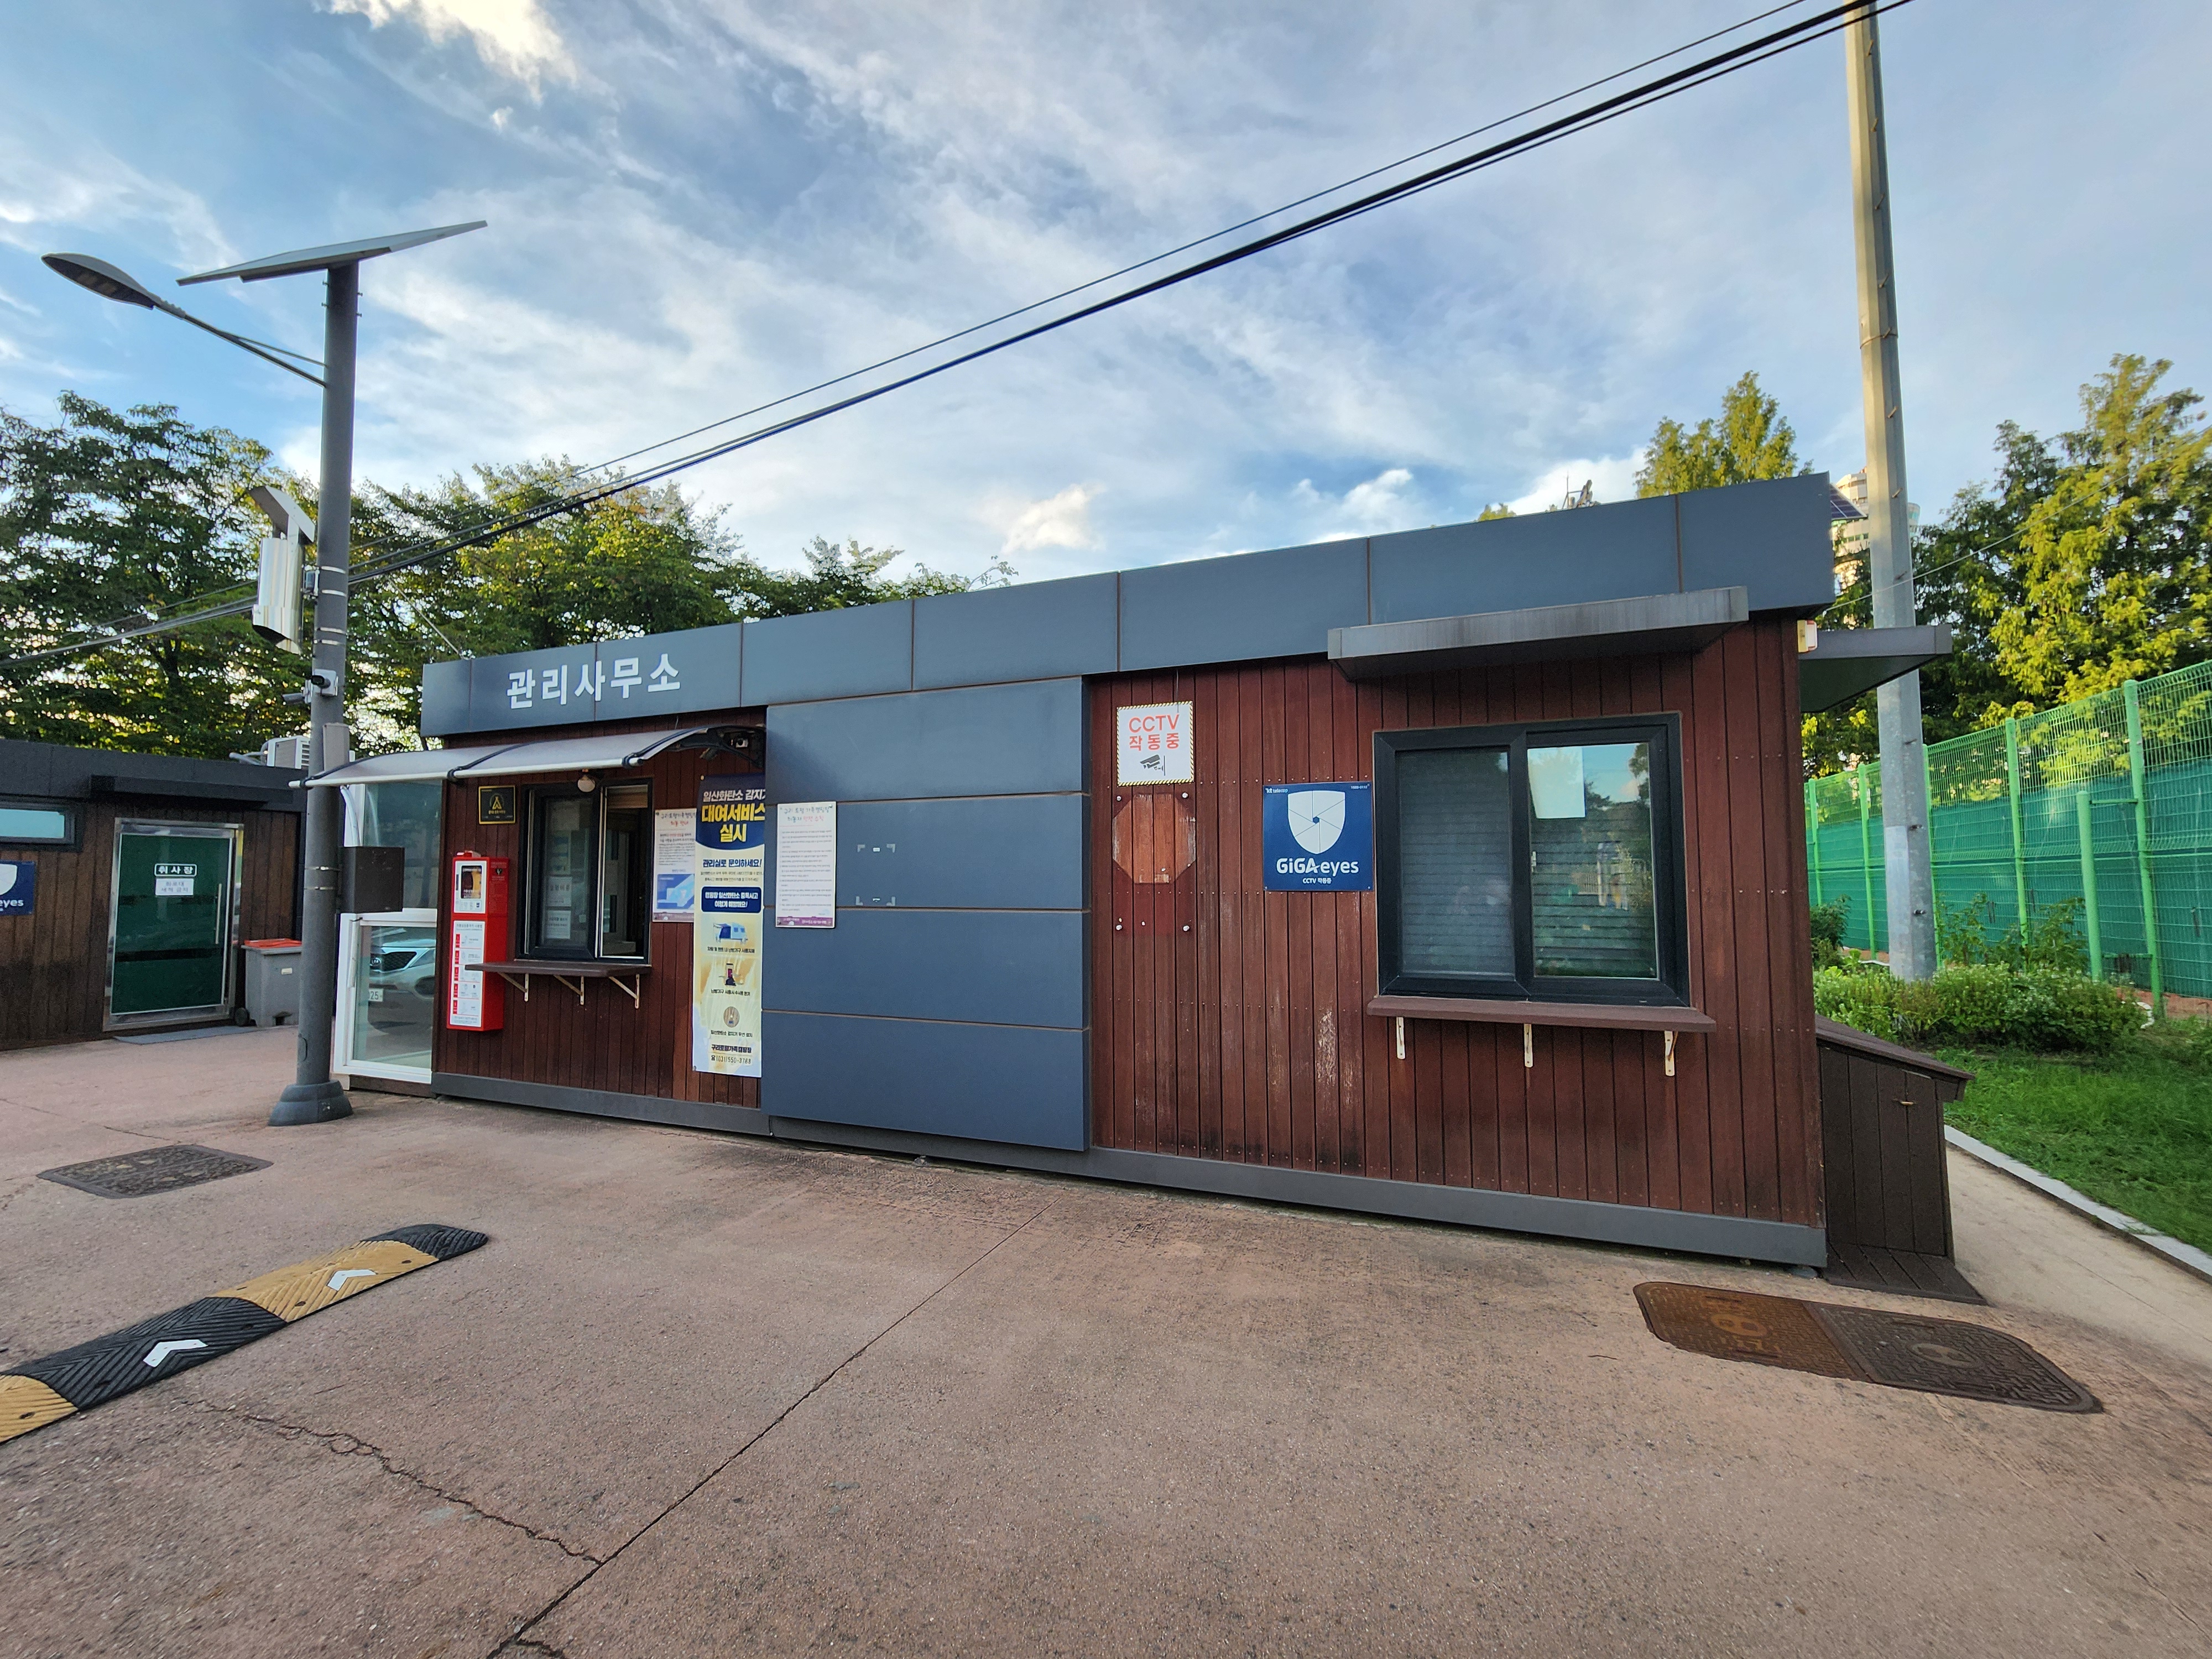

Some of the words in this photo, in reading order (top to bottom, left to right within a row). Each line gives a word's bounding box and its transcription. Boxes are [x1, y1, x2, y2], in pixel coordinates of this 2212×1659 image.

[507, 653, 681, 709] 관리사무소
[1129, 714, 1180, 733] CCTV
[703, 790, 743, 802] 일산화탄소
[702, 802, 765, 822] 대여서비스
[720, 823, 747, 842] 실시
[703, 859, 727, 868] 관리실로
[728, 859, 762, 868] 문의하세요!
